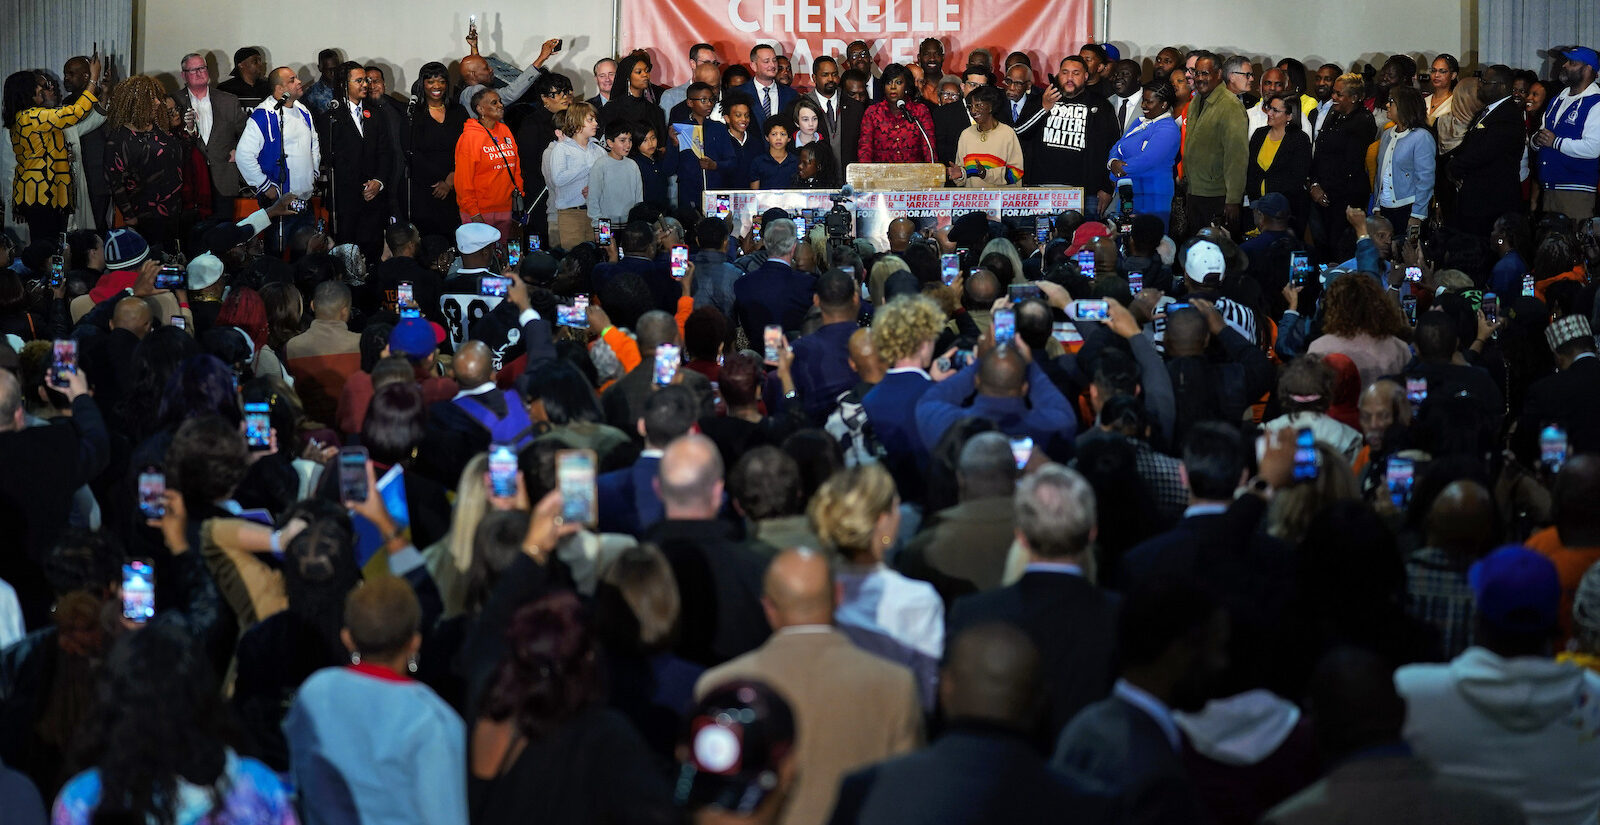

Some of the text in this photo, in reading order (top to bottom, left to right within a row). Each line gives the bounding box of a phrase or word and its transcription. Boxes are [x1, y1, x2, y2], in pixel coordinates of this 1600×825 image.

[728, 0, 961, 33] CHERELLE
[952, 193, 1000, 201] CHERELLE
[1002, 193, 1050, 201] CHERELLE
[920, 210, 951, 218] MAYOR
[1002, 209, 1018, 217] FOR
